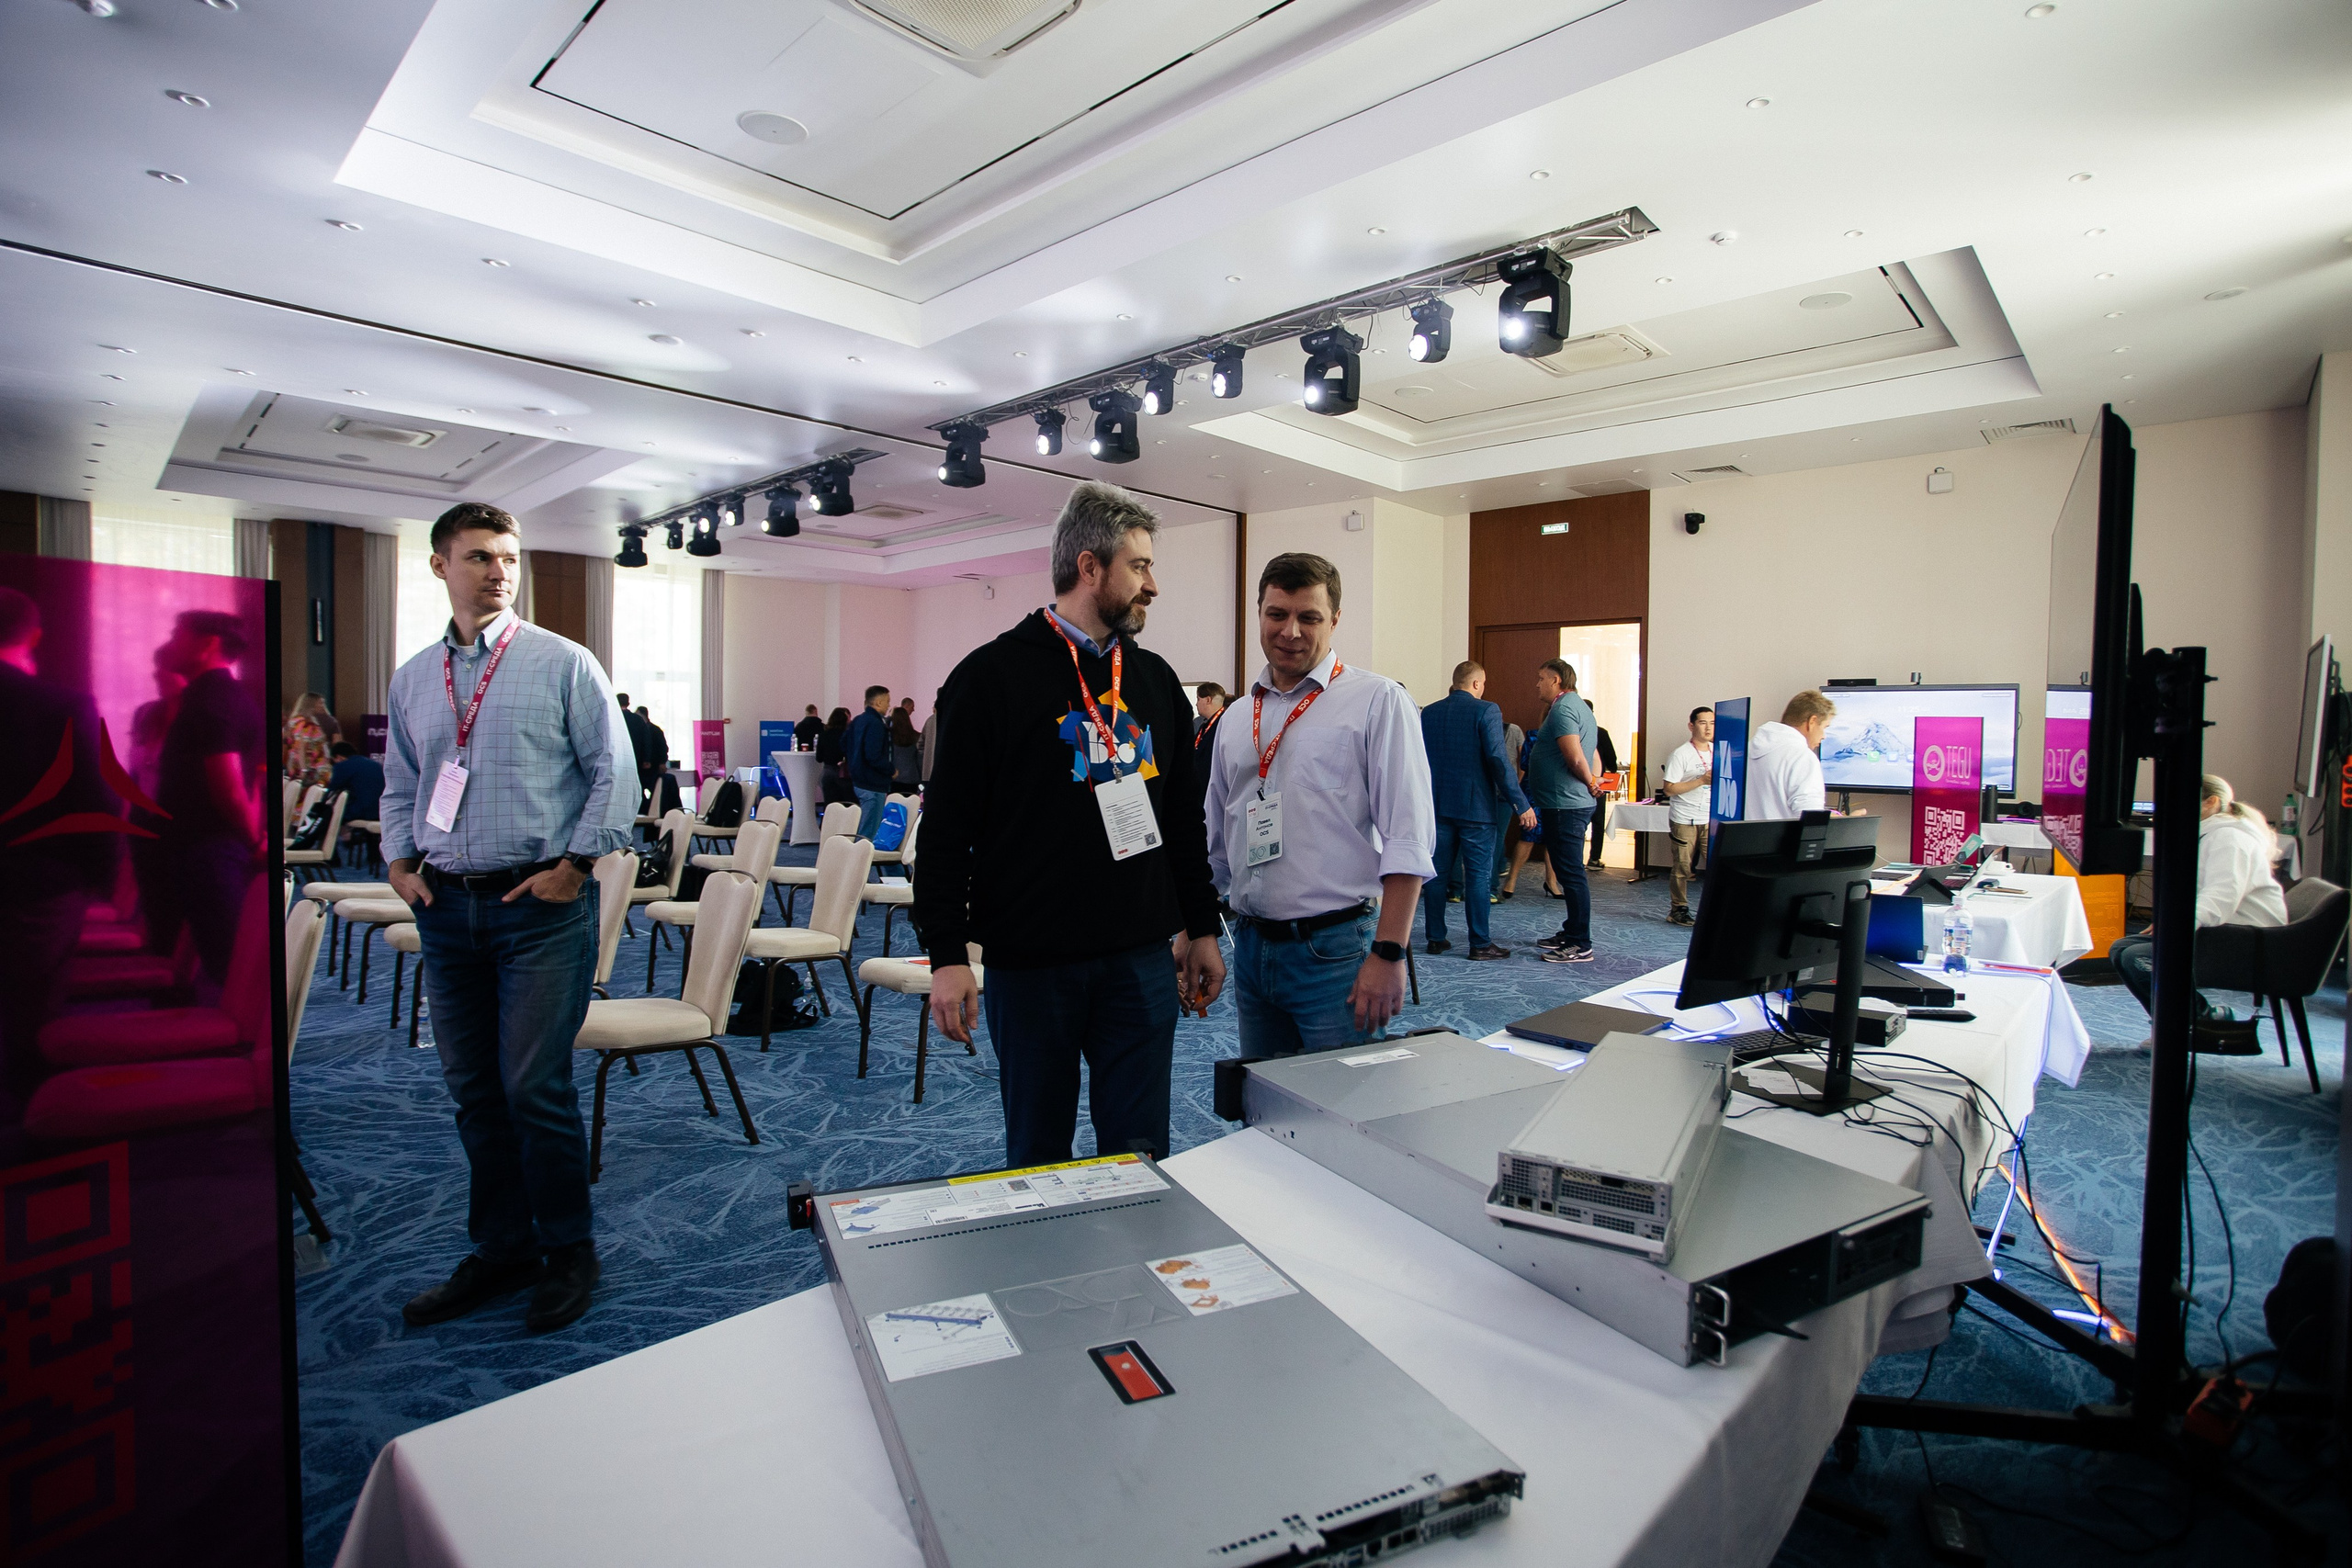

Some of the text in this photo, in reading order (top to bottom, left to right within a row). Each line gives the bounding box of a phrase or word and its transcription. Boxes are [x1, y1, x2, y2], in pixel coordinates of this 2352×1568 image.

[502, 631, 512, 644] OCS
[477, 681, 488, 694] OCS
[1297, 698, 1310, 712] OCS
[461, 701, 480, 732] IT-СРЕДА
[1089, 705, 1110, 741] IT-СРЕДА
[1946, 745, 1972, 779] TEGU
